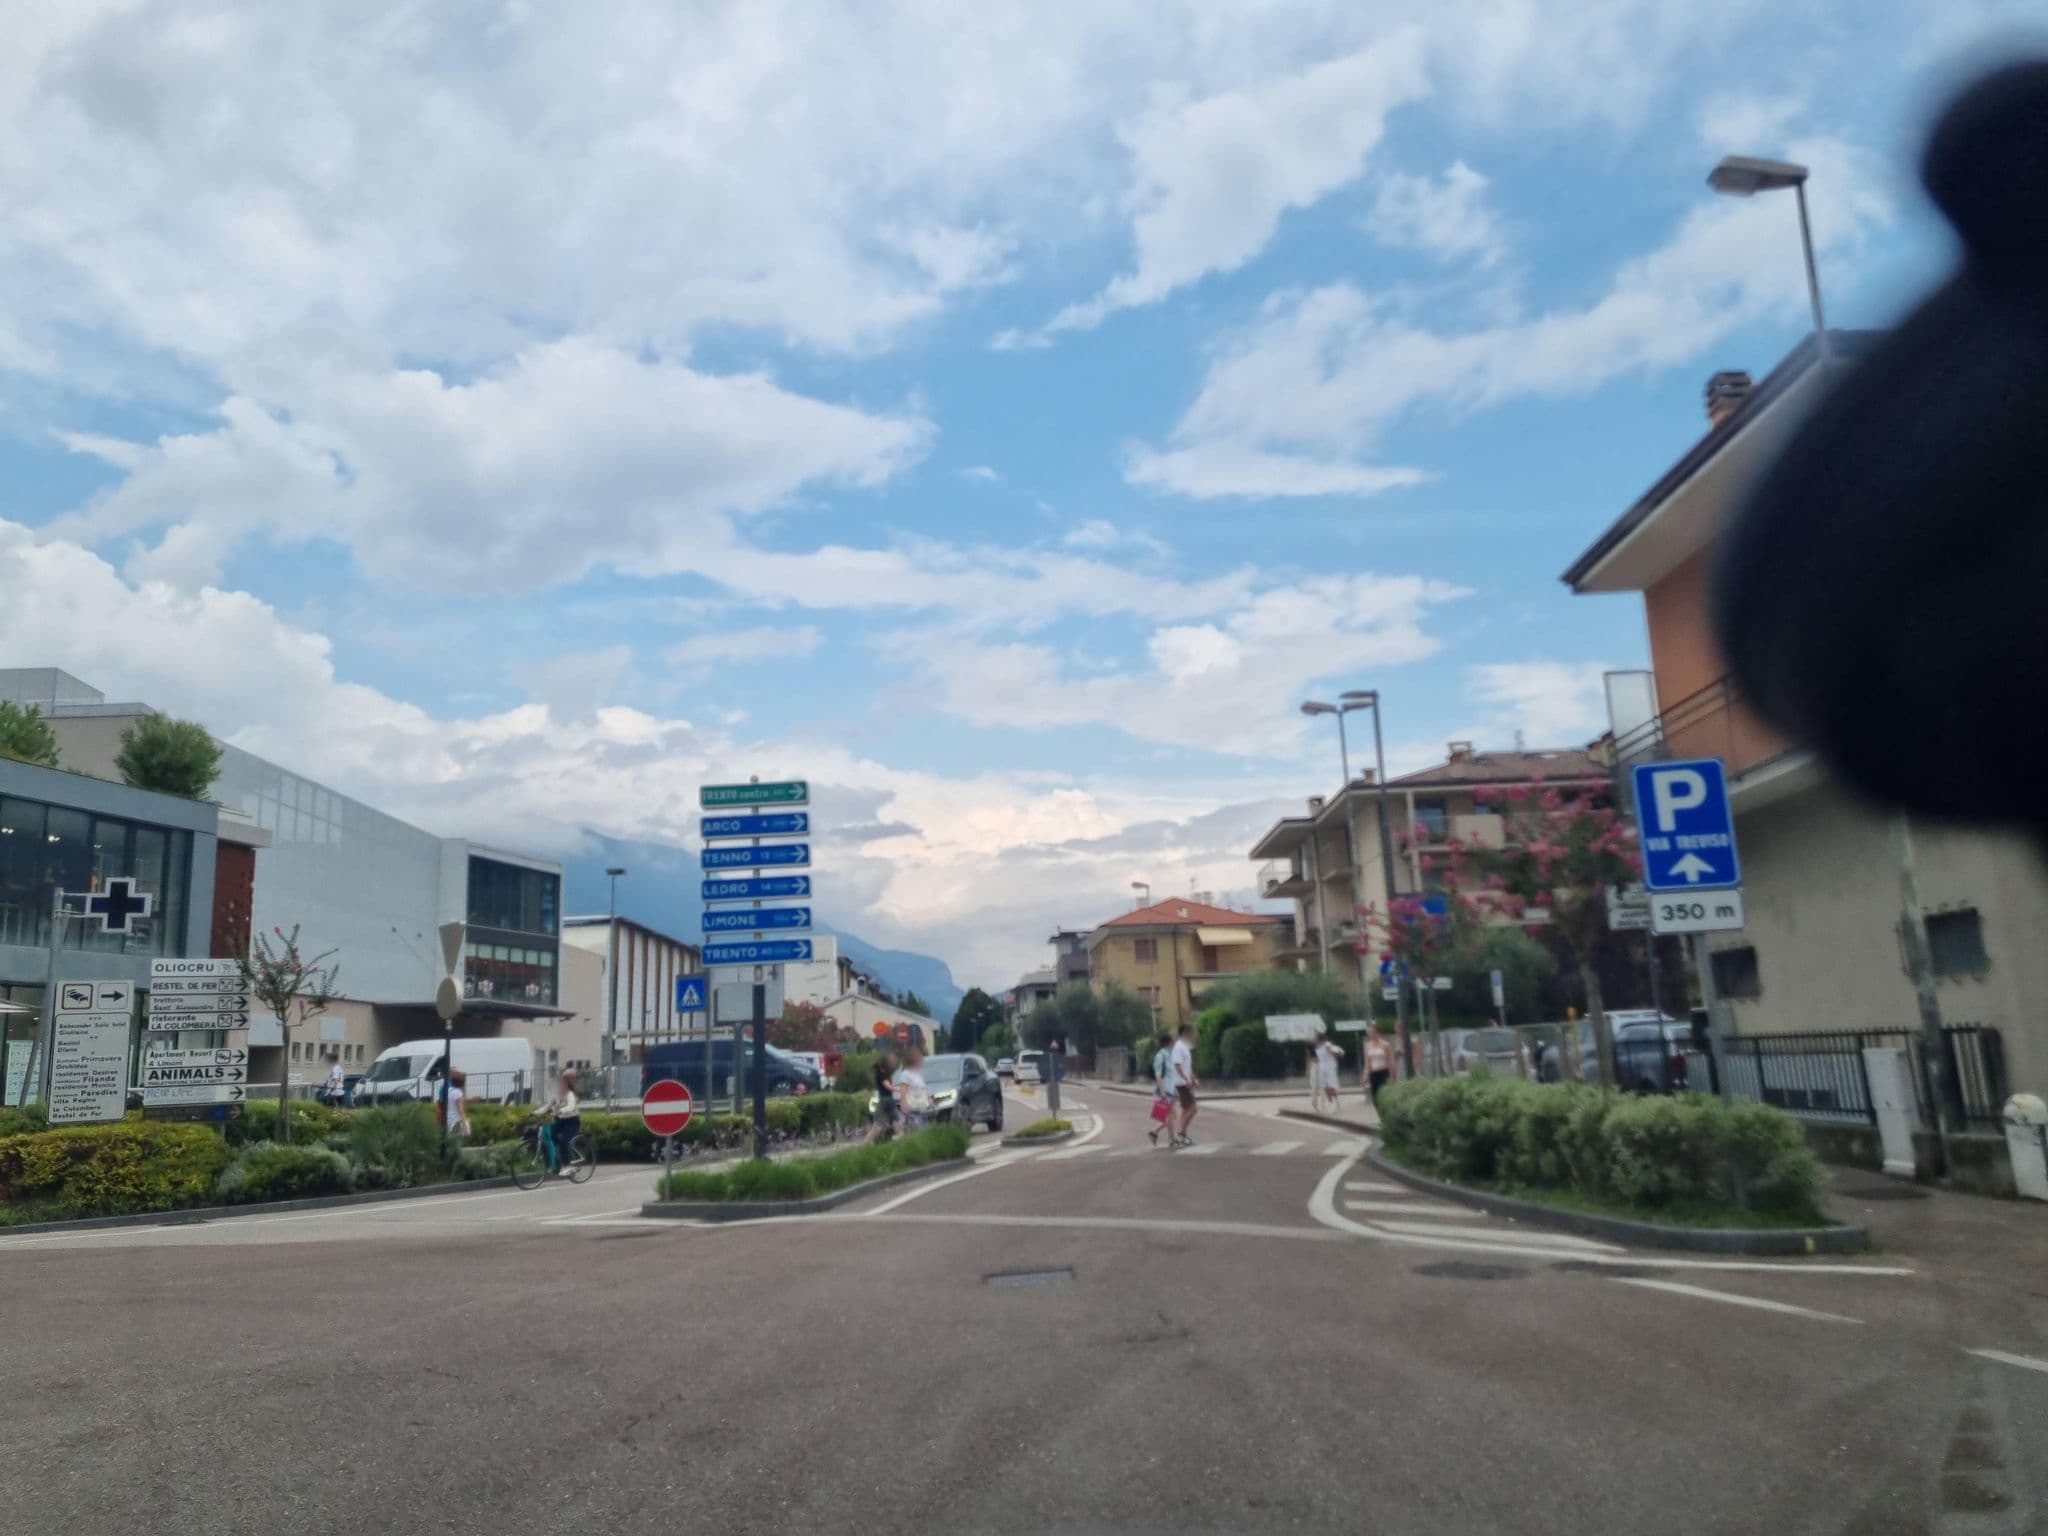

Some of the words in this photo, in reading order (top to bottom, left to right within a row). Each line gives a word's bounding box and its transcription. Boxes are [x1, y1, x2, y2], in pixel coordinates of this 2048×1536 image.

[1652, 769, 1707, 832] P
[703, 820, 741, 832] ARCO
[704, 851, 752, 864] TENNO
[703, 883, 748, 897] LEDRO
[1661, 903, 1705, 921] 350
[1715, 905, 1735, 918] m
[704, 914, 757, 928] LIMONE
[704, 946, 757, 961] TRENTO
[155, 963, 215, 973] OLIOCRU
[152, 982, 184, 990] RESTEL
[187, 982, 199, 990] DE
[201, 982, 217, 990] FER
[164, 1021, 217, 1029] COLOMBERA
[149, 1051, 186, 1059] Apartment
[148, 1067, 224, 1080] ANIMALS
